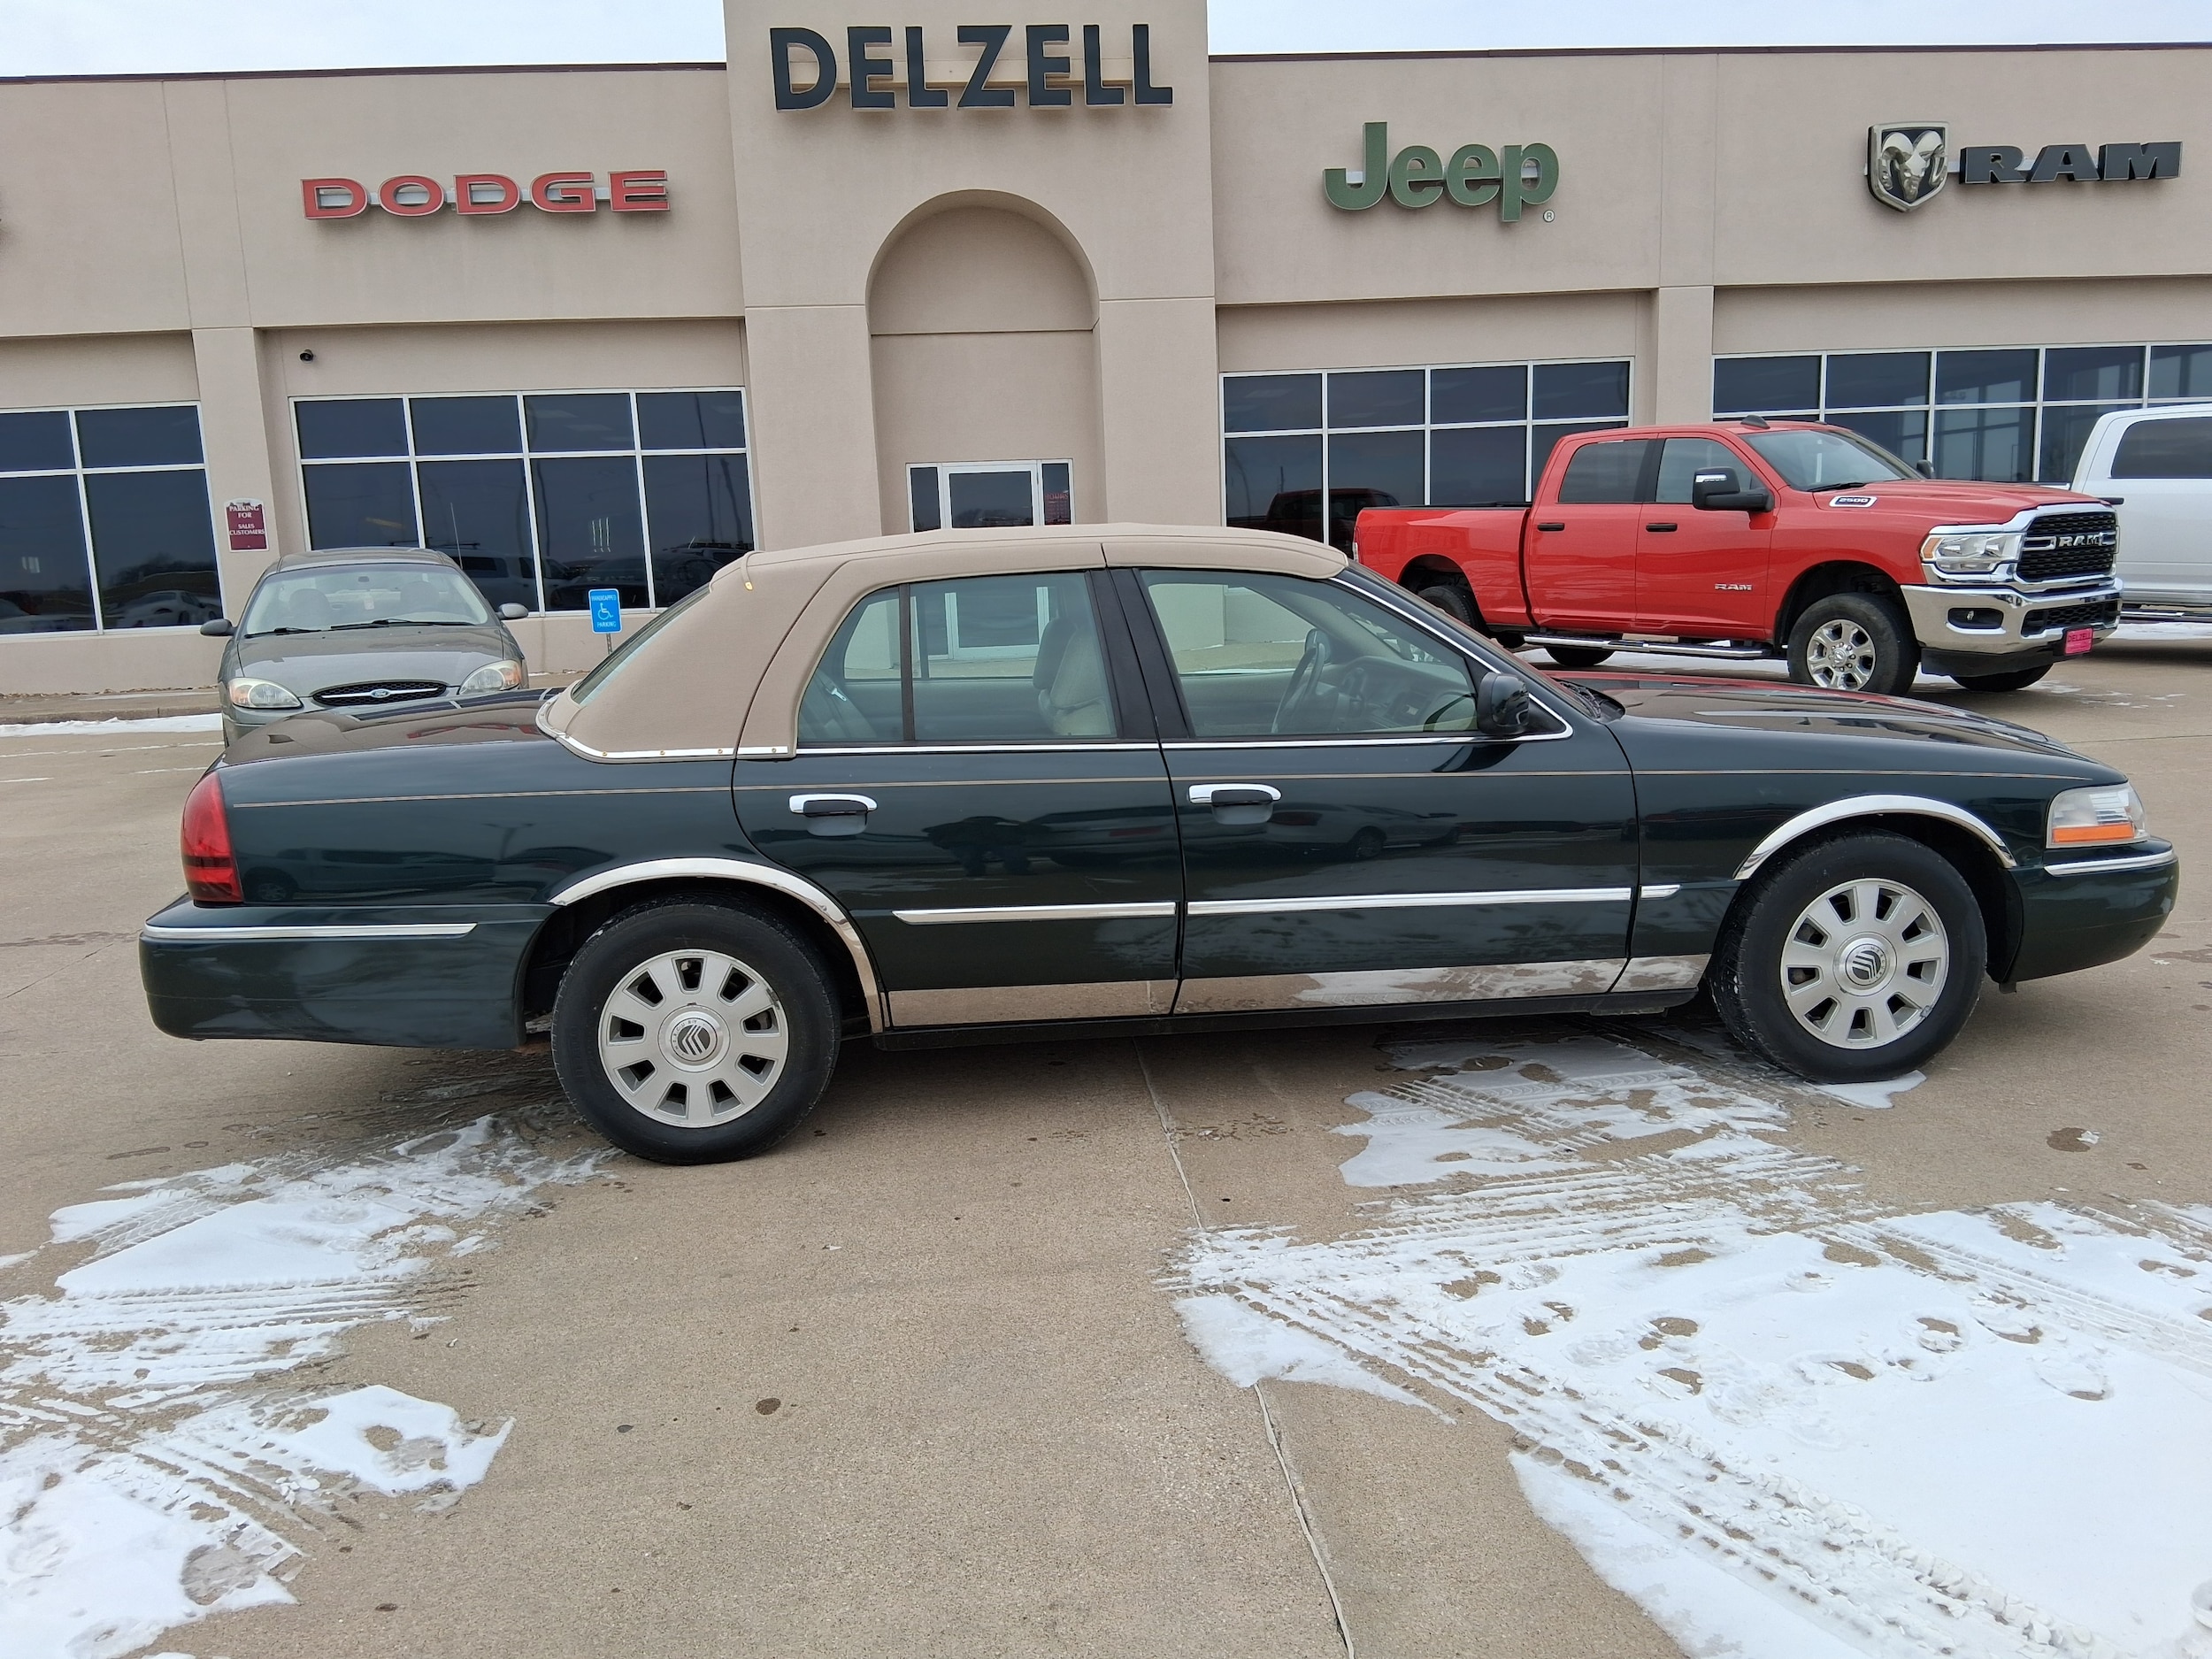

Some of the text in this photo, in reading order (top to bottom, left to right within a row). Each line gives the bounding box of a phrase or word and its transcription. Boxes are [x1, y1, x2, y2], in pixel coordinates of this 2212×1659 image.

[769, 23, 1173, 111] DELZELL
[1323, 121, 1560, 223] Jeep
[1959, 142, 2183, 184] RAM
[301, 170, 671, 219] DODGE
[2058, 534, 2102, 547] RAM
